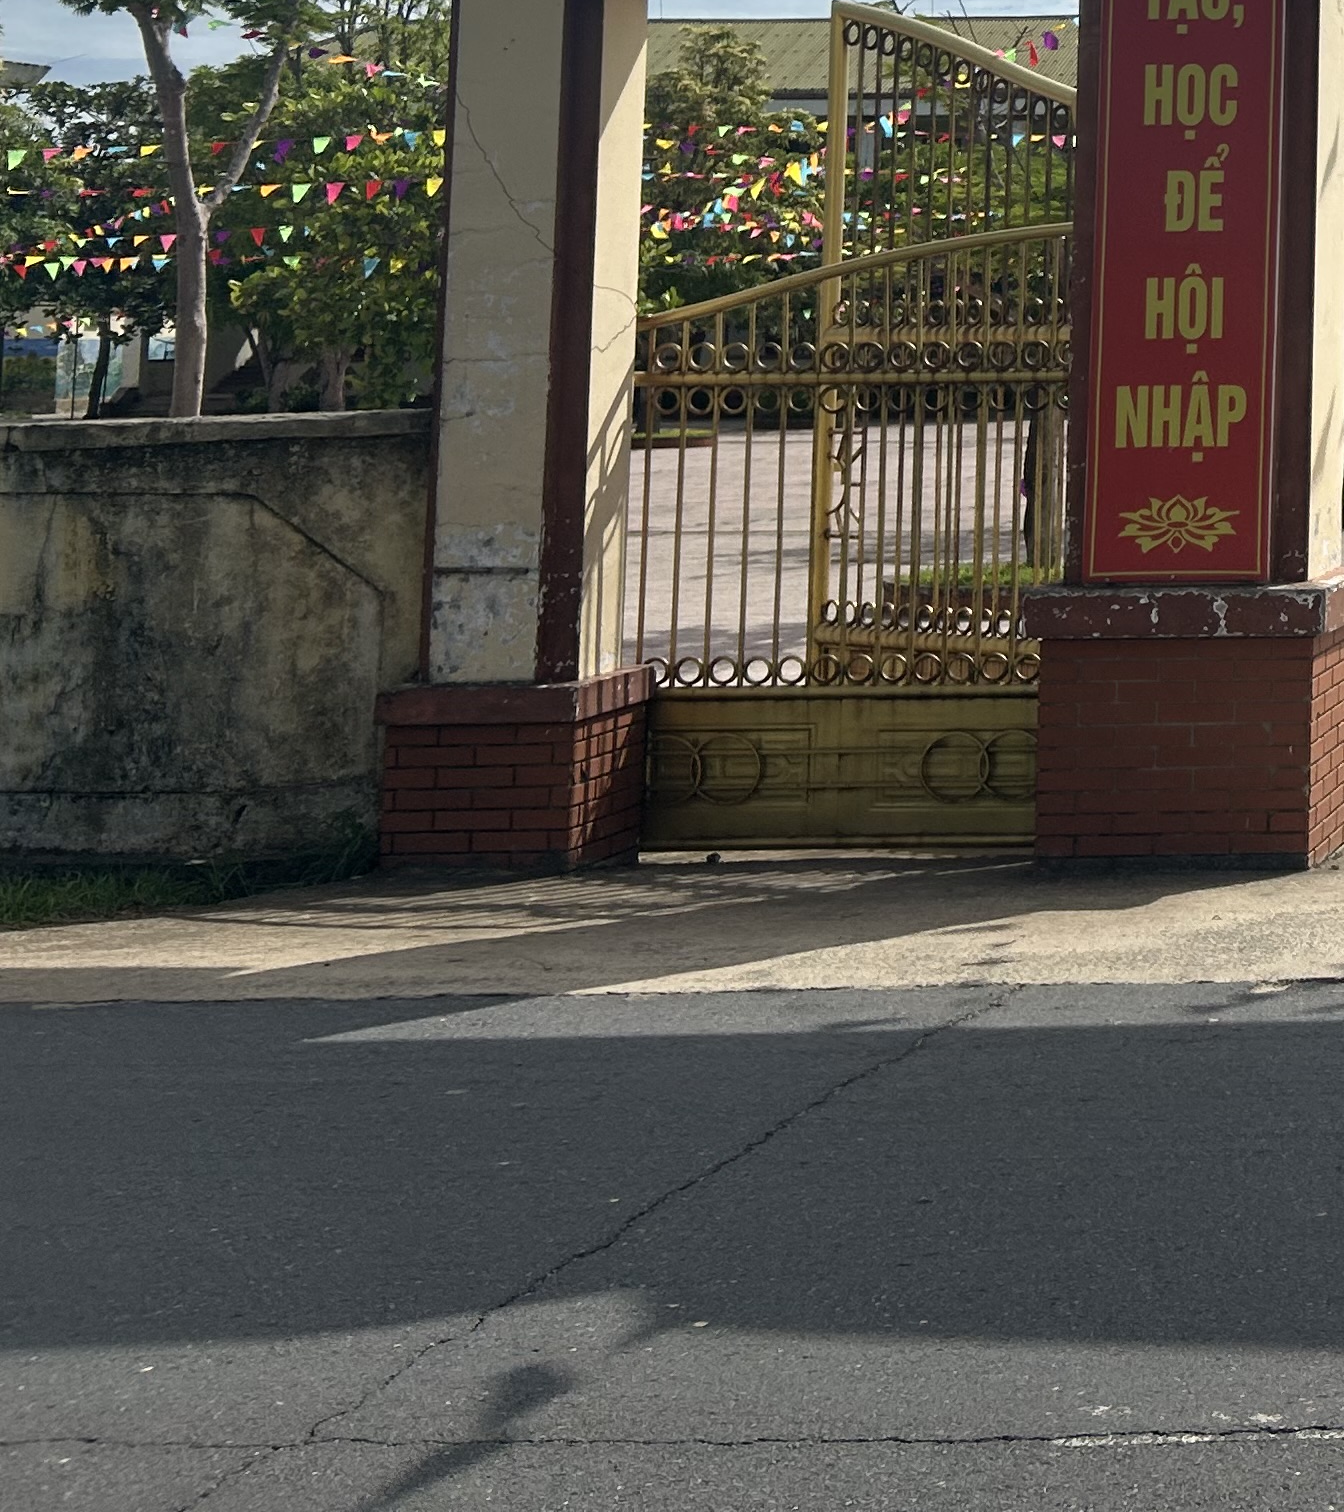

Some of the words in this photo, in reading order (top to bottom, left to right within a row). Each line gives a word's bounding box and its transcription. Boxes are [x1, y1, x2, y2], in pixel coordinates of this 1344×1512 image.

[1143, 63, 1239, 140] HỌC
[1164, 143, 1230, 233] ĐỂ
[1144, 263, 1226, 355] HỘI
[1114, 370, 1248, 463] NHẬP
